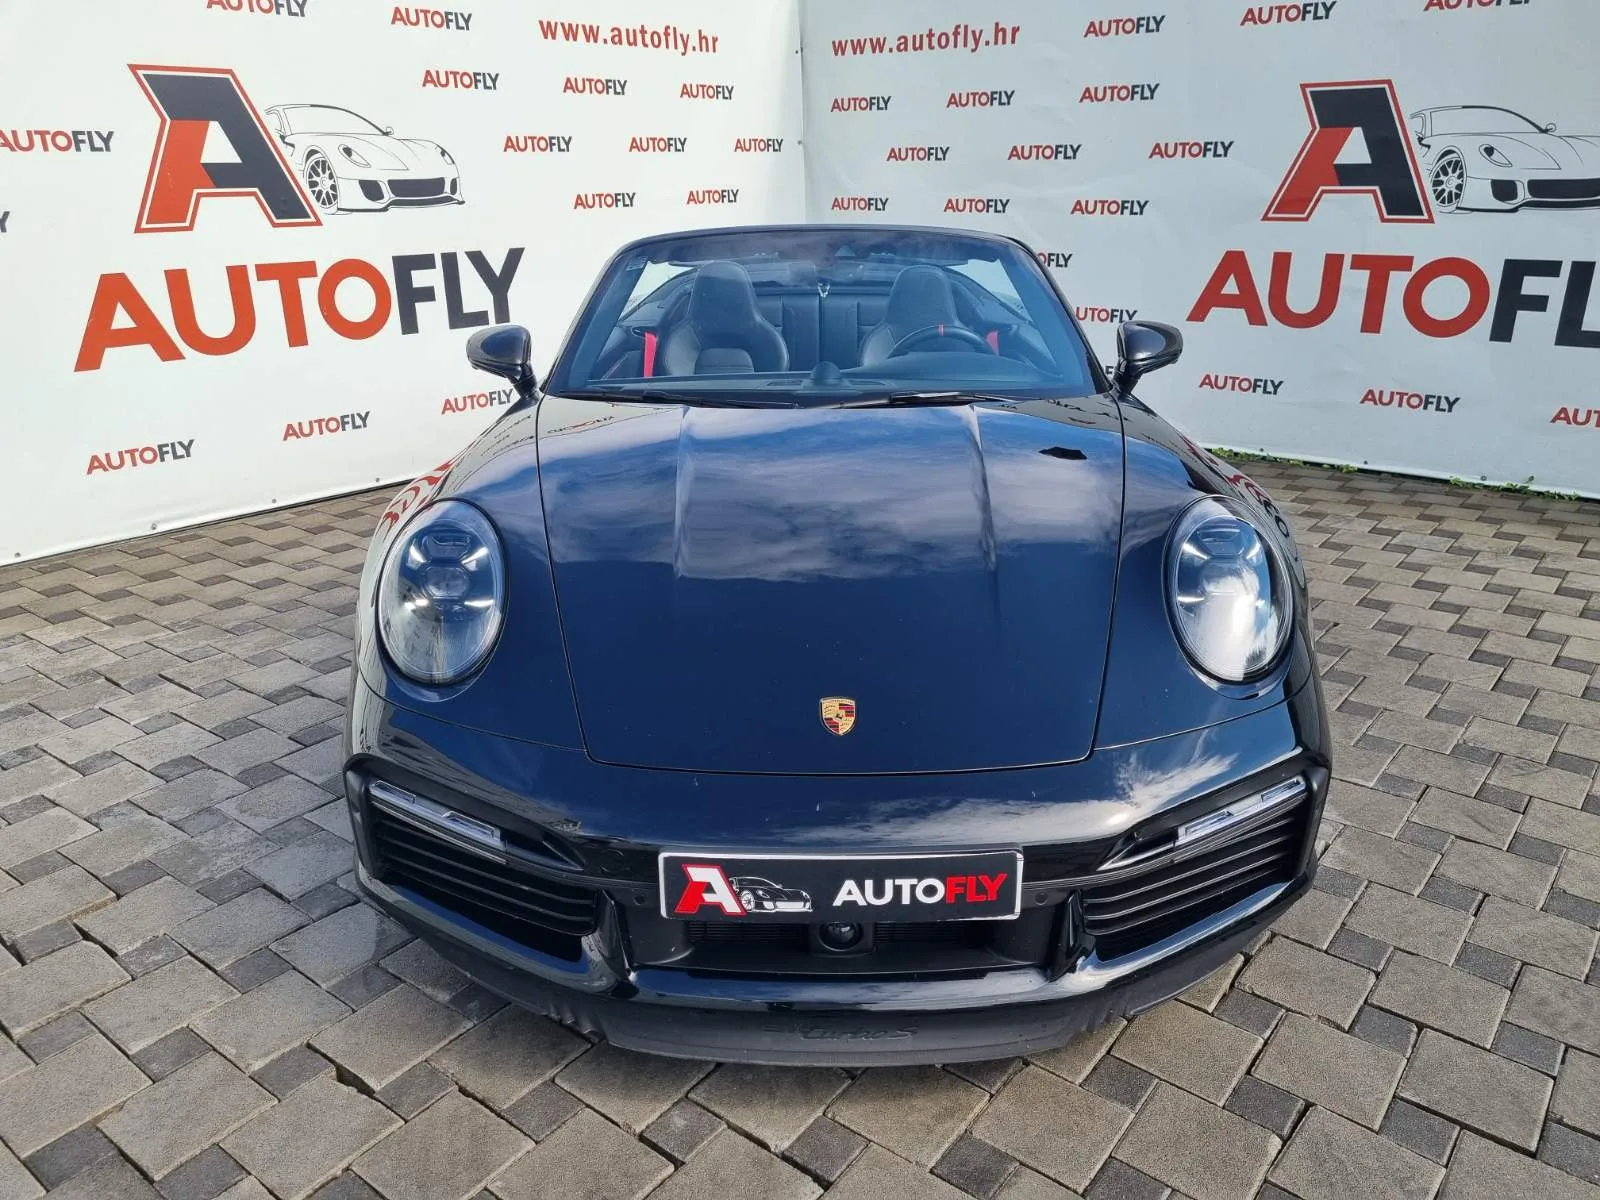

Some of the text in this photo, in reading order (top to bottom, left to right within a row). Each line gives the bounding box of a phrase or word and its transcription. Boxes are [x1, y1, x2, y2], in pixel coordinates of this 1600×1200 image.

[391, 7, 472, 31] AUTOFLY
[1240, 1, 1337, 26] AUTOFLY
[1084, 15, 1166, 38] AUTOFLY
[538, 20, 718, 56] www.autofly.hr
[832, 22, 1020, 56] www.autofly.hr
[422, 70, 499, 91] AUTOFLY
[563, 77, 628, 96] AUTOFLY
[680, 83, 735, 100] AUTOFLY
[946, 90, 1015, 108] AUTOFLY
[1079, 83, 1160, 103] AUTOFLY
[830, 96, 892, 112] AUTOFLY
[504, 136, 572, 153] AUTOFLY
[629, 137, 688, 152] AUTOFLY
[734, 138, 784, 152] AUTOFLY
[886, 146, 950, 162] AUTOFLY
[1008, 144, 1082, 160] AUTOFLY
[1148, 141, 1234, 159] AUTOFLY
[573, 192, 636, 209] AUTOFLY
[687, 189, 739, 205] AUTOFLY
[831, 197, 889, 212] AUTOFLY
[944, 198, 1010, 214] AUTOFLY
[1071, 200, 1149, 216] AUTOFLY
[1186, 250, 1600, 348] AUTOFL
[74, 247, 525, 373] AUTOFLY
[1075, 306, 1138, 323] UTOFLY
[1199, 374, 1284, 395] AUTOFLY
[441, 388, 513, 415] AUTOFLY
[1360, 389, 1460, 413] AUTOFLY
[283, 411, 370, 441] AUTOFLY
[87, 439, 194, 475] AUTOFLY
[832, 873, 1008, 906] AUTOFLY
